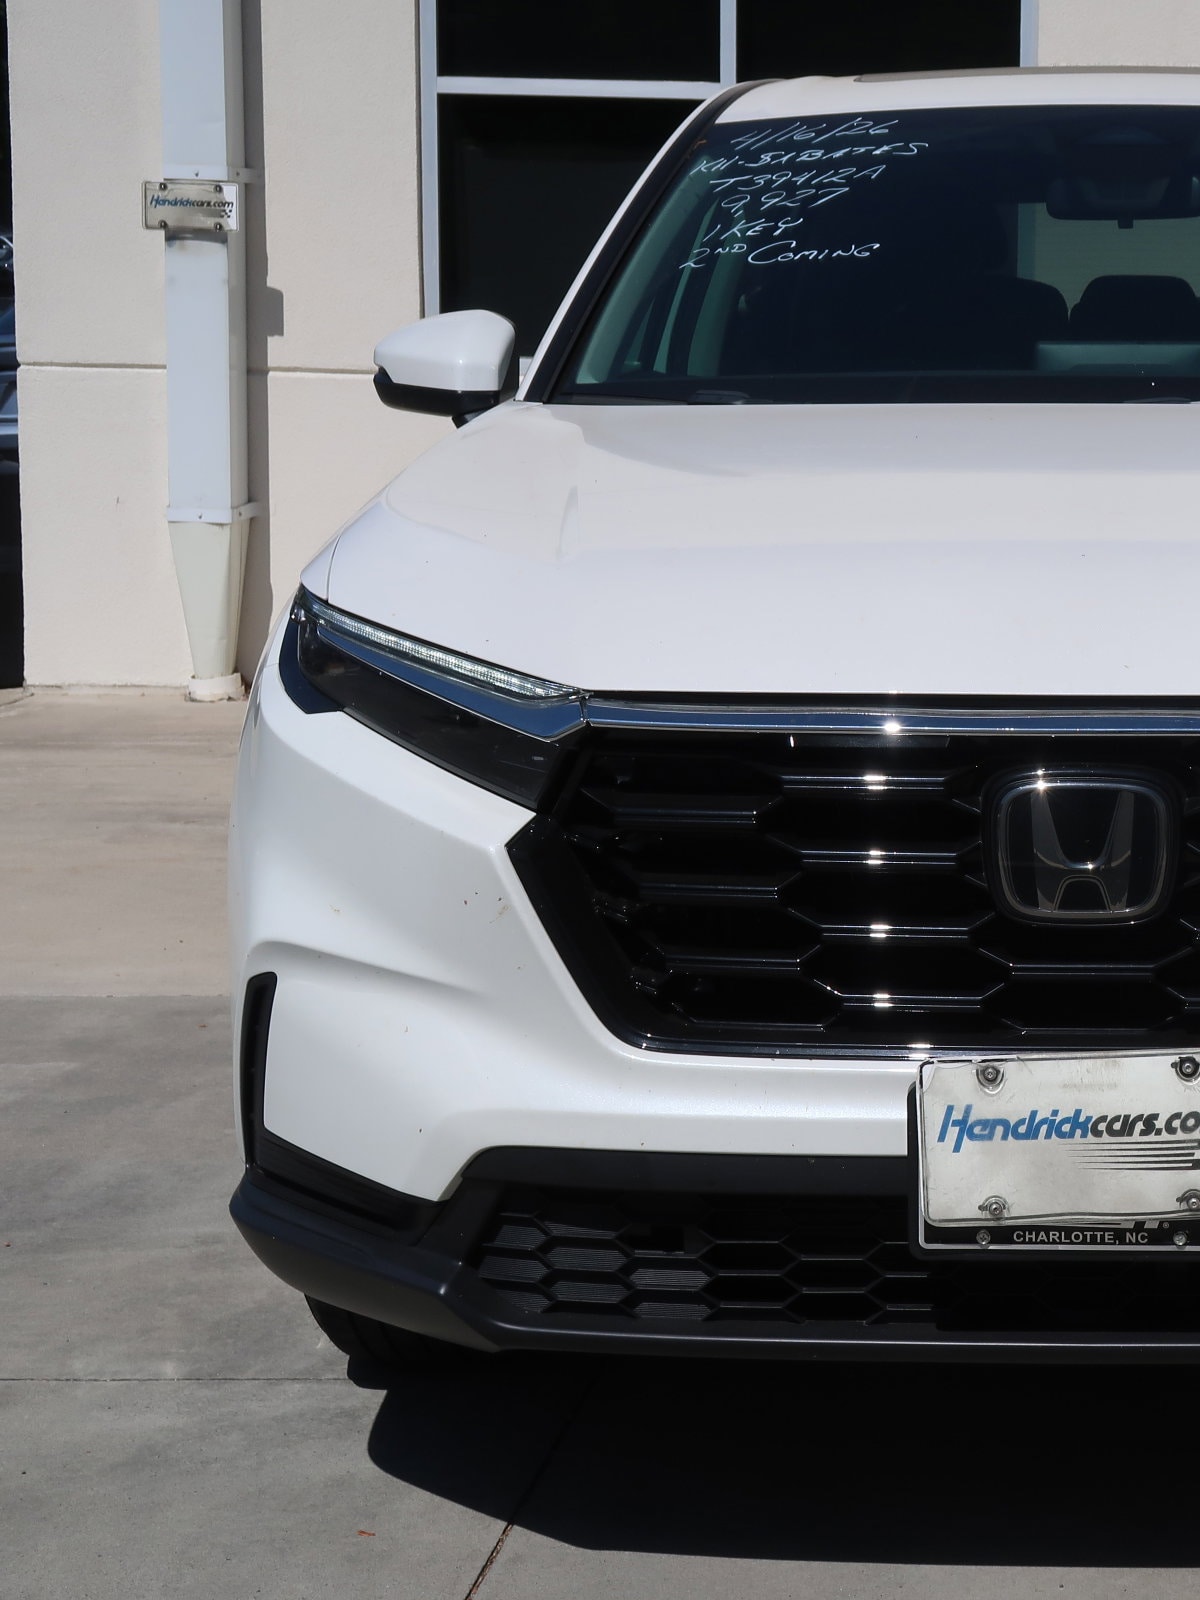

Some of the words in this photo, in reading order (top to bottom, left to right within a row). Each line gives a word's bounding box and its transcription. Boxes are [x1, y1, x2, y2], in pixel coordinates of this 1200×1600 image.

[730, 116, 899, 150] 4/16/26
[709, 165, 886, 193] T39412A
[150, 194, 234, 208] Hendrickcars.com
[720, 217, 804, 240] KEY
[1013, 1230, 1120, 1245] CHARLOTTE,
[1125, 1231, 1149, 1244] NC
